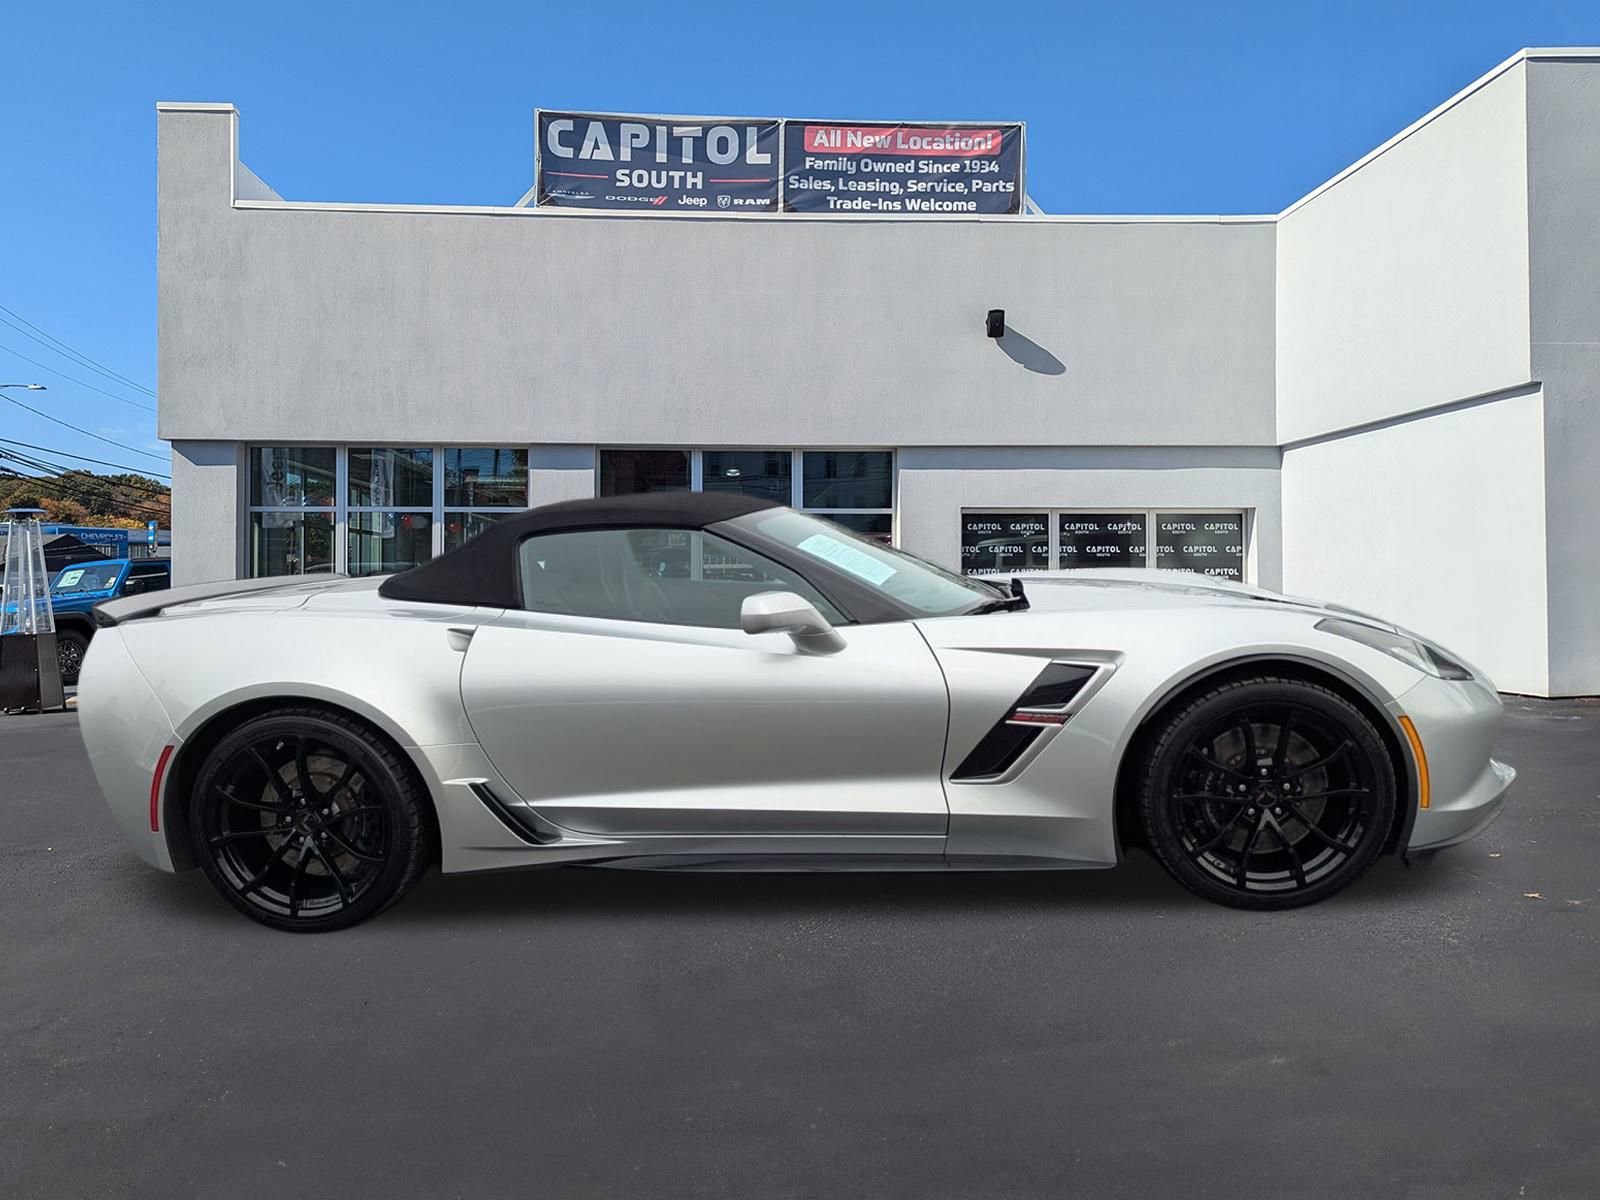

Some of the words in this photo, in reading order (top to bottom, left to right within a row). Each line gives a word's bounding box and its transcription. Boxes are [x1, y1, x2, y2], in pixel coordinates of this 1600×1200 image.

[547, 119, 771, 165] CAPITOL
[813, 129, 841, 147] All
[847, 131, 890, 148] New
[896, 133, 993, 151] Location!
[805, 157, 856, 174] Family
[860, 158, 915, 173] Owned
[918, 159, 960, 173] Since
[963, 160, 1000, 173] 1934
[615, 169, 703, 189] SOUTH
[789, 176, 835, 192] Sales,
[839, 177, 904, 195] Leasing,
[907, 179, 968, 195] Service,
[972, 180, 1015, 193] Parts
[678, 194, 708, 207] Jeep
[826, 196, 902, 211] Trade-Ins
[905, 198, 977, 212] Welcome
